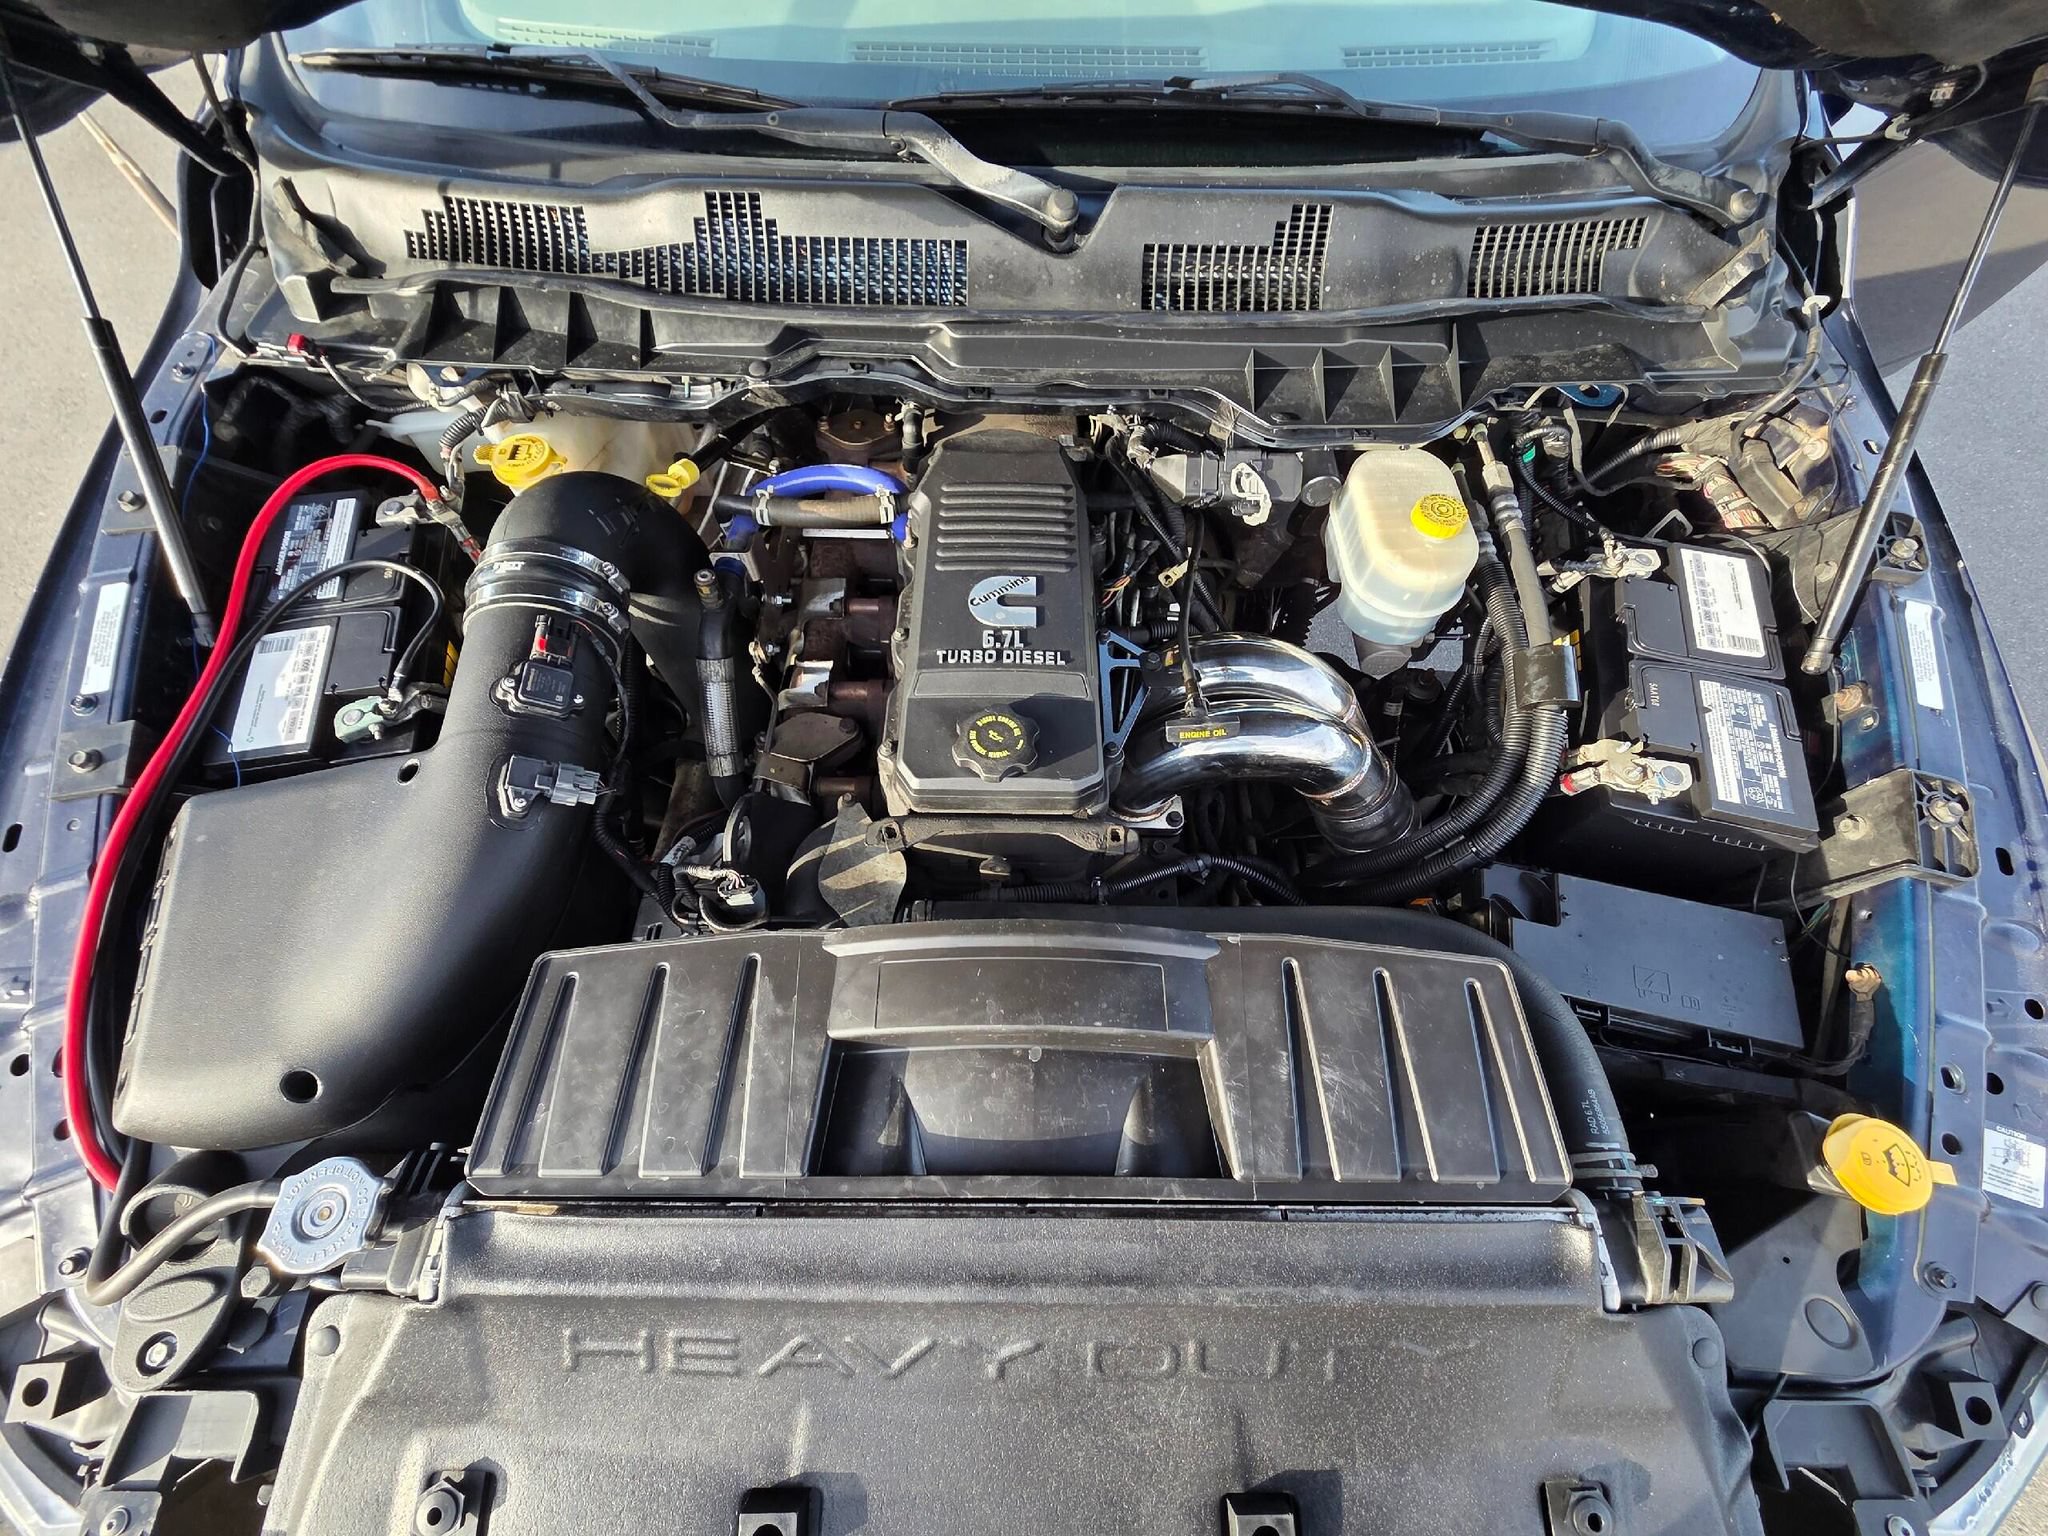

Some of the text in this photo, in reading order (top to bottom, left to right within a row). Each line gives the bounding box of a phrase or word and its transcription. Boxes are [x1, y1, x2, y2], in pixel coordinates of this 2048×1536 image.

[969, 576, 1031, 607] Cummins
[982, 630, 1024, 649] 6.7L
[936, 649, 1066, 665] TURBO DIESEL
[1179, 728, 1227, 739] ENGINE OIL
[562, 1326, 1042, 1382] HEAVY
